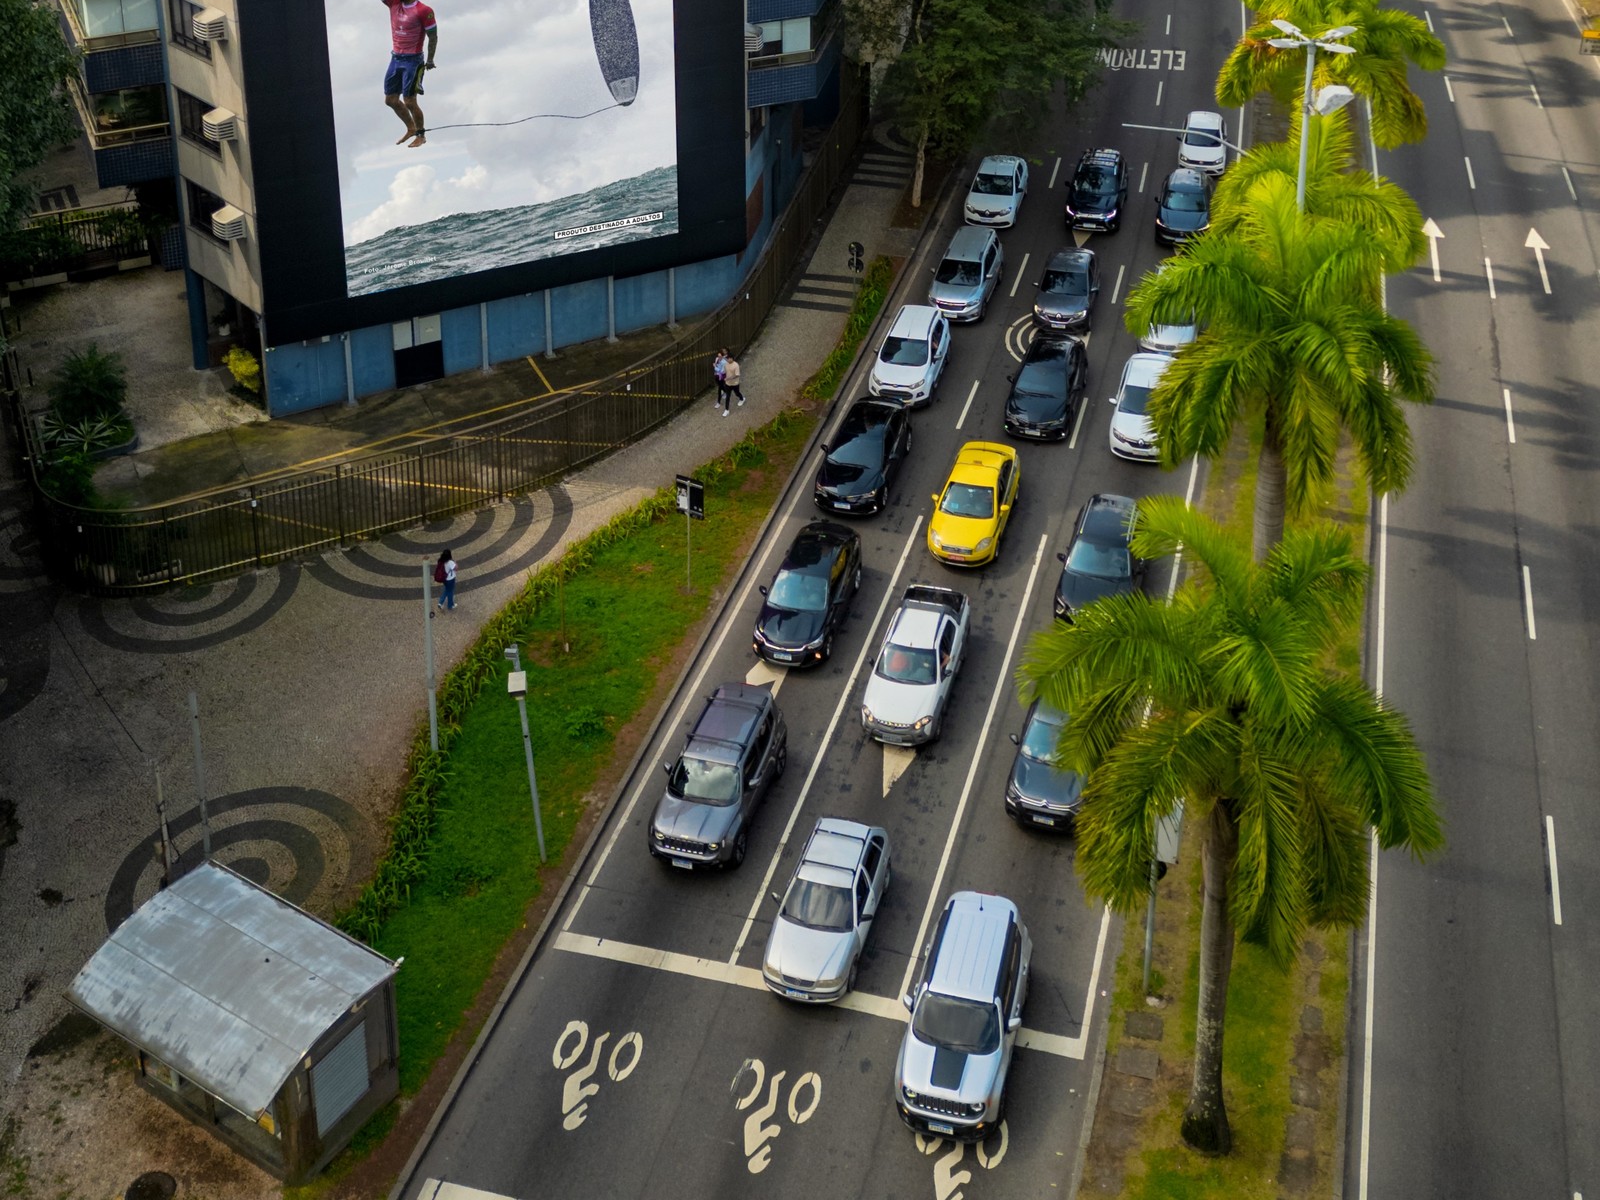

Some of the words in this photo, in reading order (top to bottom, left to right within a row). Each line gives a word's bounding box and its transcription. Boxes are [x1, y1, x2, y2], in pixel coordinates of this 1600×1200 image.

[557, 228, 588, 238] PRODUTO
[589, 220, 625, 232] DESTINADO
[632, 213, 661, 224] ADULTOS
